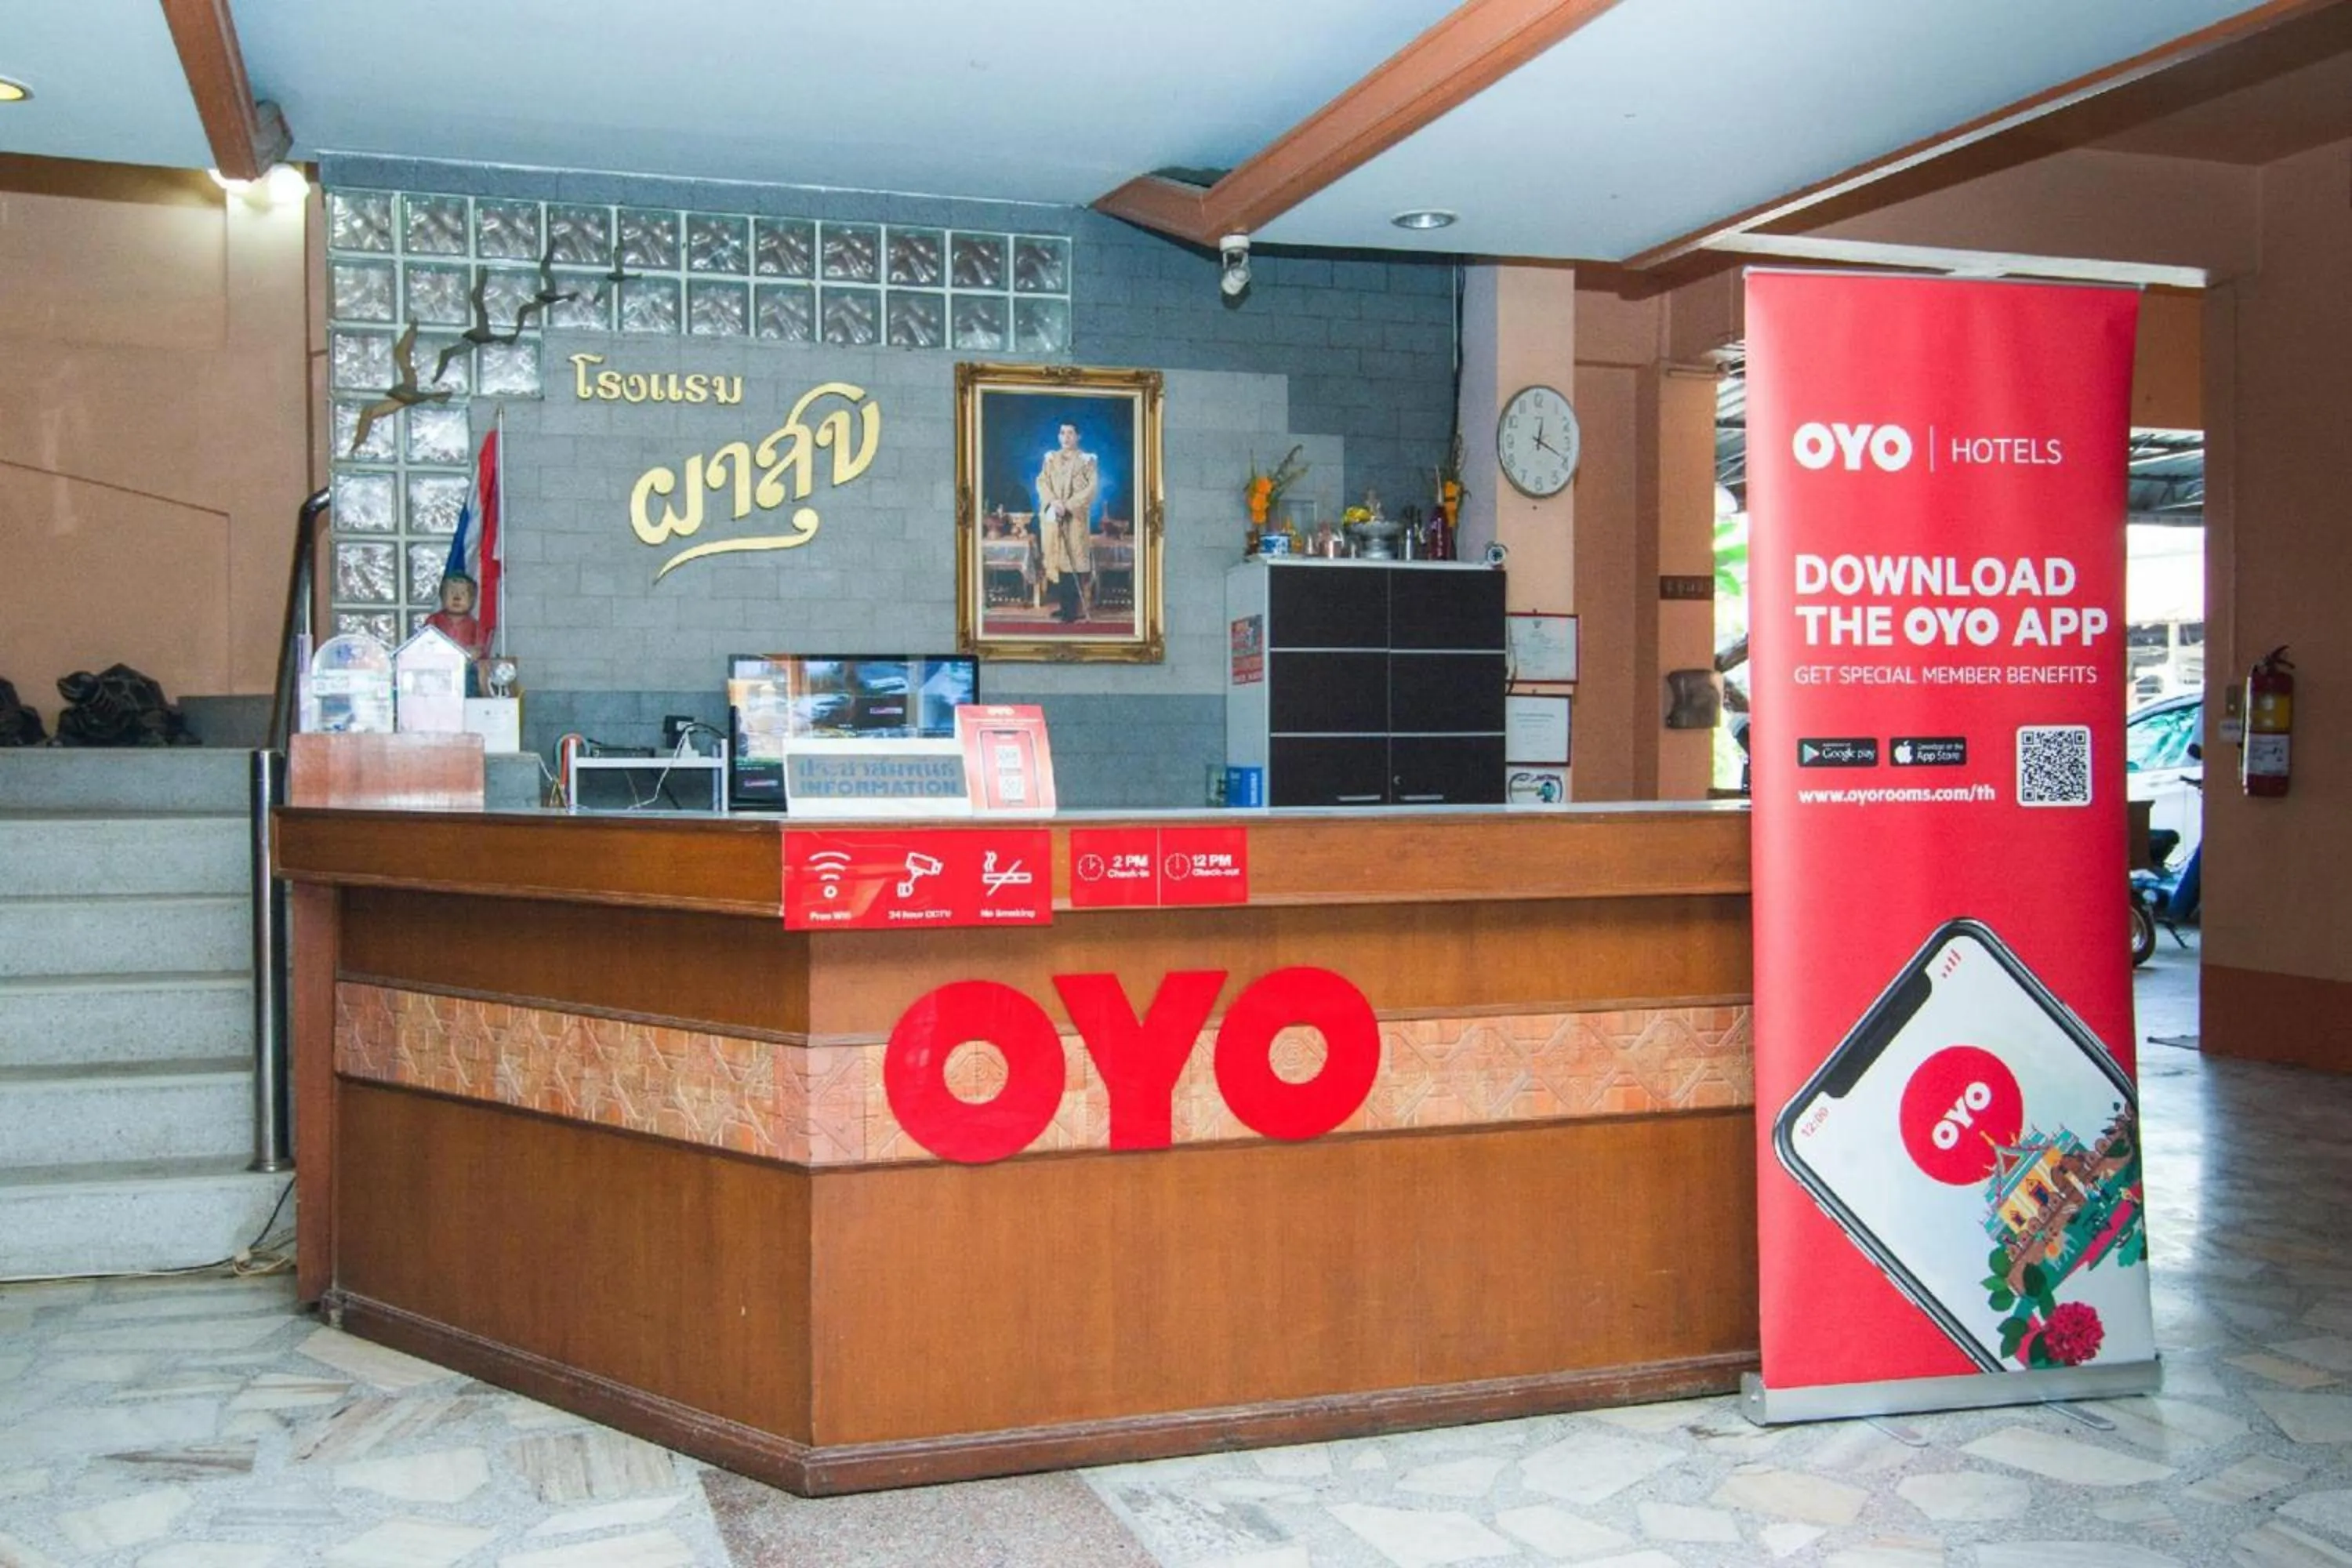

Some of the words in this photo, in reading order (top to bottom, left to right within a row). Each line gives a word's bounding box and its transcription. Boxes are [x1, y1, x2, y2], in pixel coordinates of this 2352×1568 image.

[568, 353, 743, 405] โรงแรม
[1792, 423, 1913, 472] OYO
[1951, 438, 2062, 465] HOTELS
[630, 381, 880, 586] ผาสุข
[1795, 554, 2076, 596] DOWNLOAD
[1795, 606, 1893, 646] THE
[1904, 607, 1999, 646] OYO
[2013, 608, 2108, 646] APP
[1794, 666, 1835, 684] GET
[1839, 666, 1918, 684] SPECIAL
[1922, 666, 2002, 684] MEMBER
[2007, 666, 2097, 684] BENEFITS
[1822, 746, 1855, 762] Google
[1917, 751, 1935, 762] App
[1937, 751, 1960, 760] Store
[800, 780, 957, 795] INFORMATION
[1798, 784, 1996, 806] www.oyorooms.com/th
[1112, 855, 1123, 867] 2
[1126, 855, 1149, 867] PM
[1192, 855, 1207, 867] 12
[1209, 854, 1232, 866] PM
[810, 911, 831, 920] Free
[981, 909, 995, 918] No
[884, 965, 1381, 1164] OYO
[1800, 1106, 1830, 1138] 12:00
[1932, 1081, 1992, 1151] OYO
